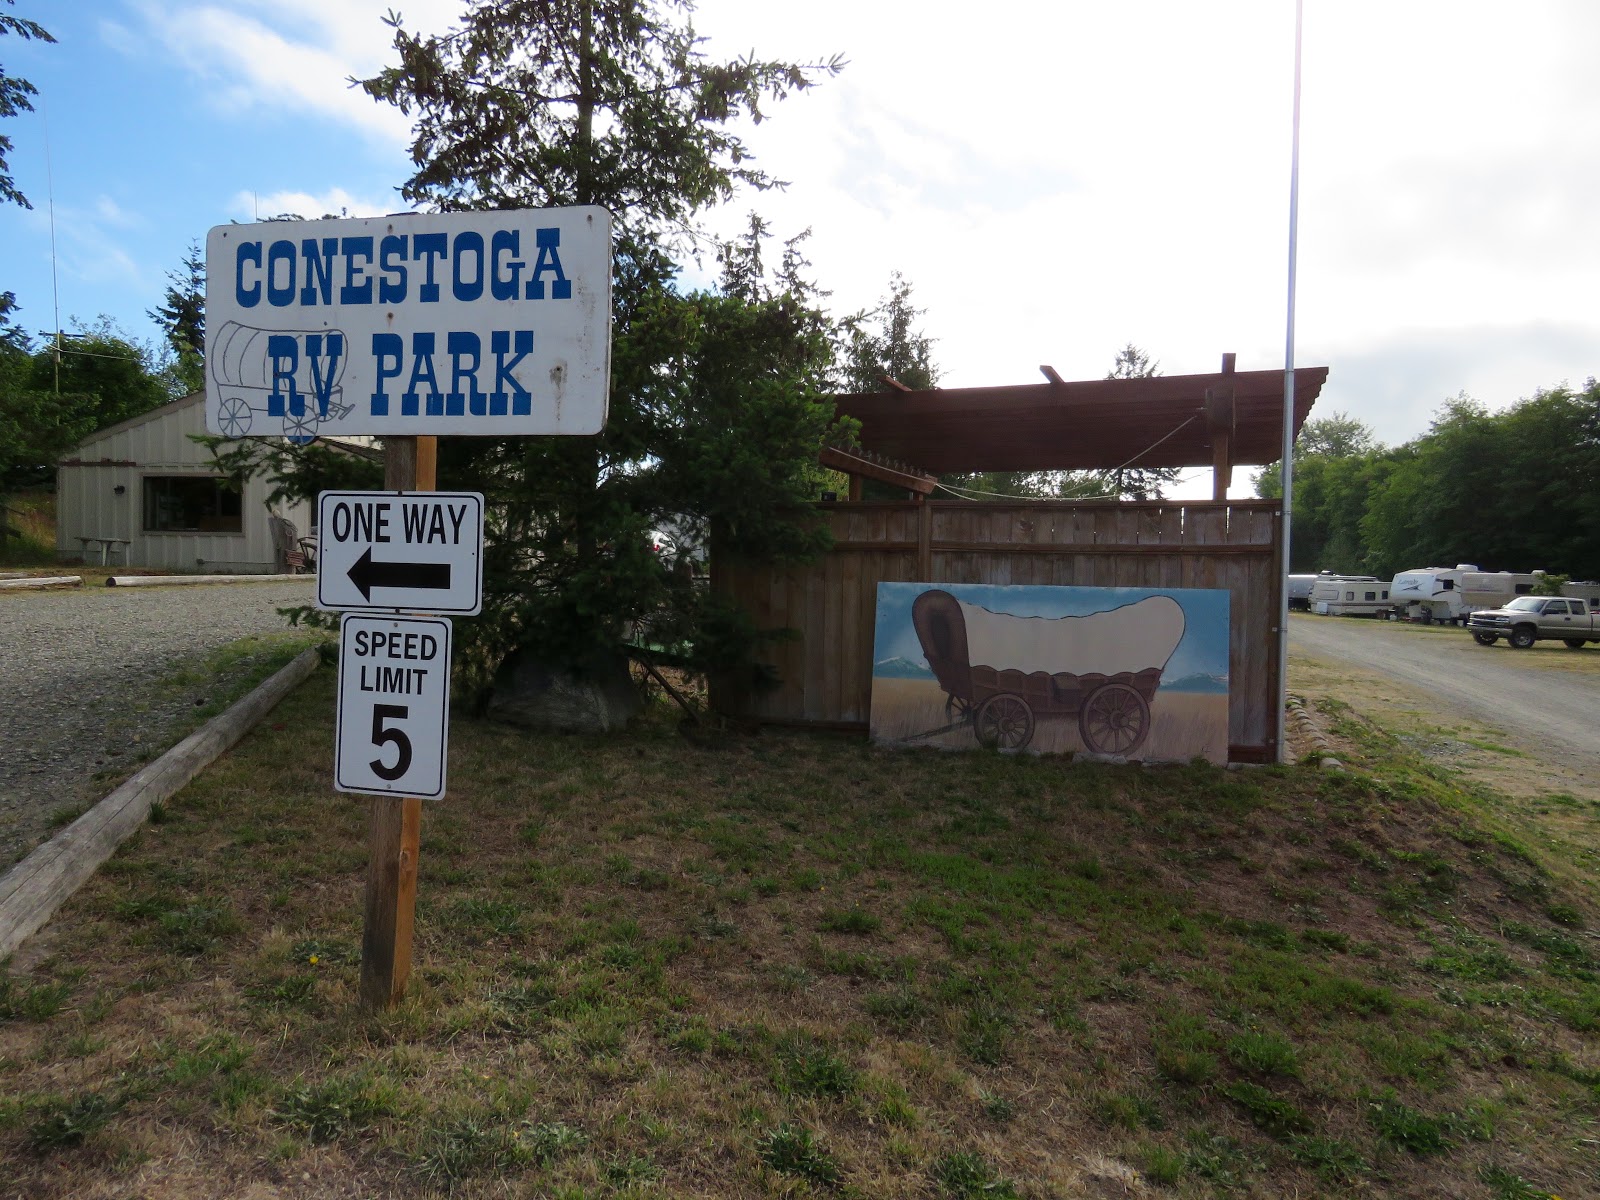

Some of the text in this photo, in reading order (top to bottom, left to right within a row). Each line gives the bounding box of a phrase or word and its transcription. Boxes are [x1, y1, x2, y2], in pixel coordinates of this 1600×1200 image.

[236, 227, 572, 308] CONESTOGA
[268, 330, 534, 417] RV PARK
[332, 502, 467, 545] ONE WAY
[354, 630, 438, 661] SPEED
[360, 665, 428, 695] LIMIT
[369, 703, 413, 781] 5
